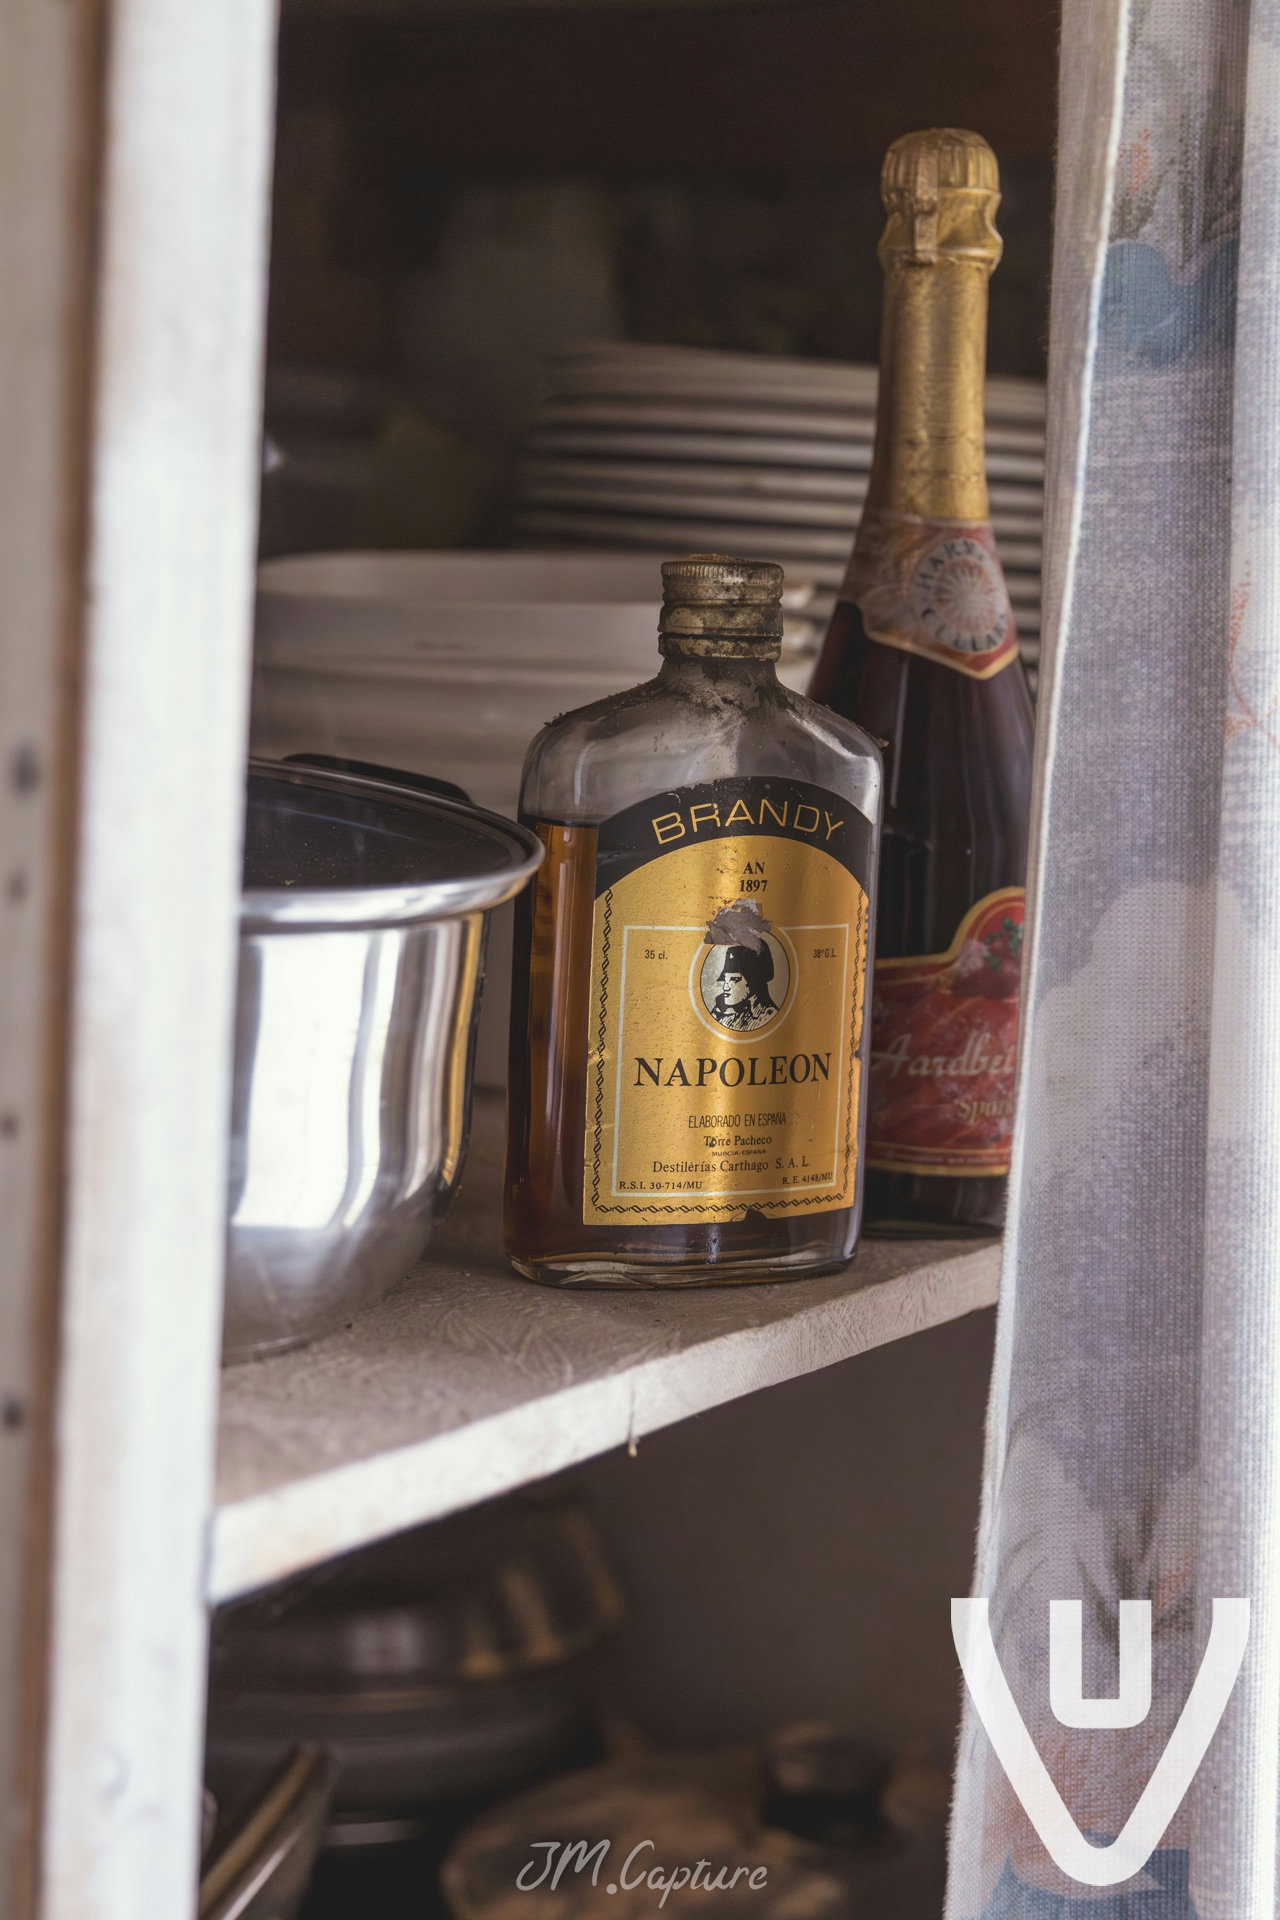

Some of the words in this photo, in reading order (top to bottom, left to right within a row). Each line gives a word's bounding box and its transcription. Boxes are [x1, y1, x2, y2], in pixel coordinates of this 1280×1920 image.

[651, 798, 845, 845] BRANDY
[743, 860, 765, 875] AN
[740, 879, 768, 893] 1897
[644, 949, 656, 960] 35
[658, 950, 668, 960] cl.
[633, 1052, 832, 1088] NAPOLEON
[688, 1113, 741, 1129] ELABORADO
[744, 1112, 756, 1127] EN
[757, 1111, 787, 1126] ESPAÑA
[704, 1135, 731, 1148] Torre
[734, 1135, 772, 1146] Pacheco
[652, 1160, 717, 1174] Destilerías
[720, 1159, 769, 1173] Carthago
[619, 1181, 646, 1190] R.S.I.
[649, 1181, 703, 1190] 30-714/MU
